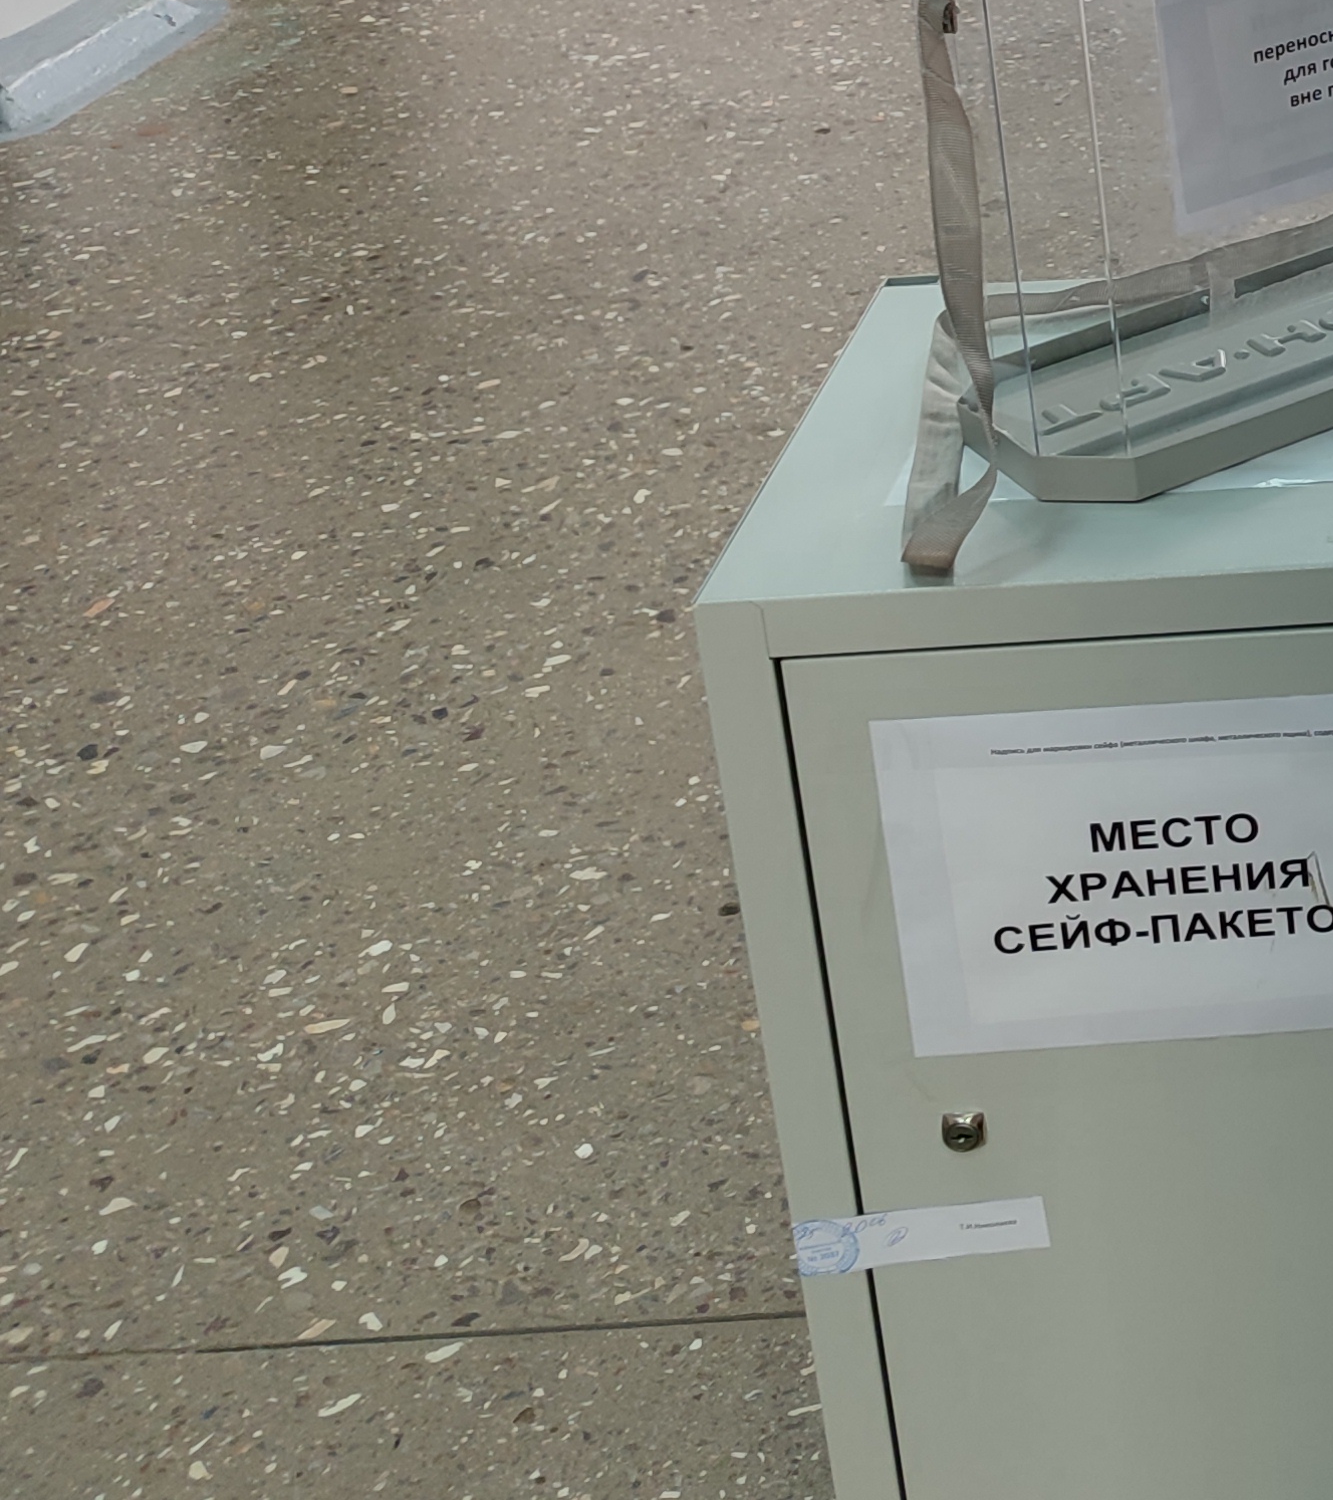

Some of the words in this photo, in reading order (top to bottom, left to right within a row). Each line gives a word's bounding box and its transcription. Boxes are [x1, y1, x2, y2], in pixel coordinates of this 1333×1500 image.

[1283, 62, 1317, 86] для
[1290, 88, 1322, 108] вне
[1089, 813, 1259, 853] МЕСТО
[1046, 858, 1311, 904] ХРАНЕНИЯ
